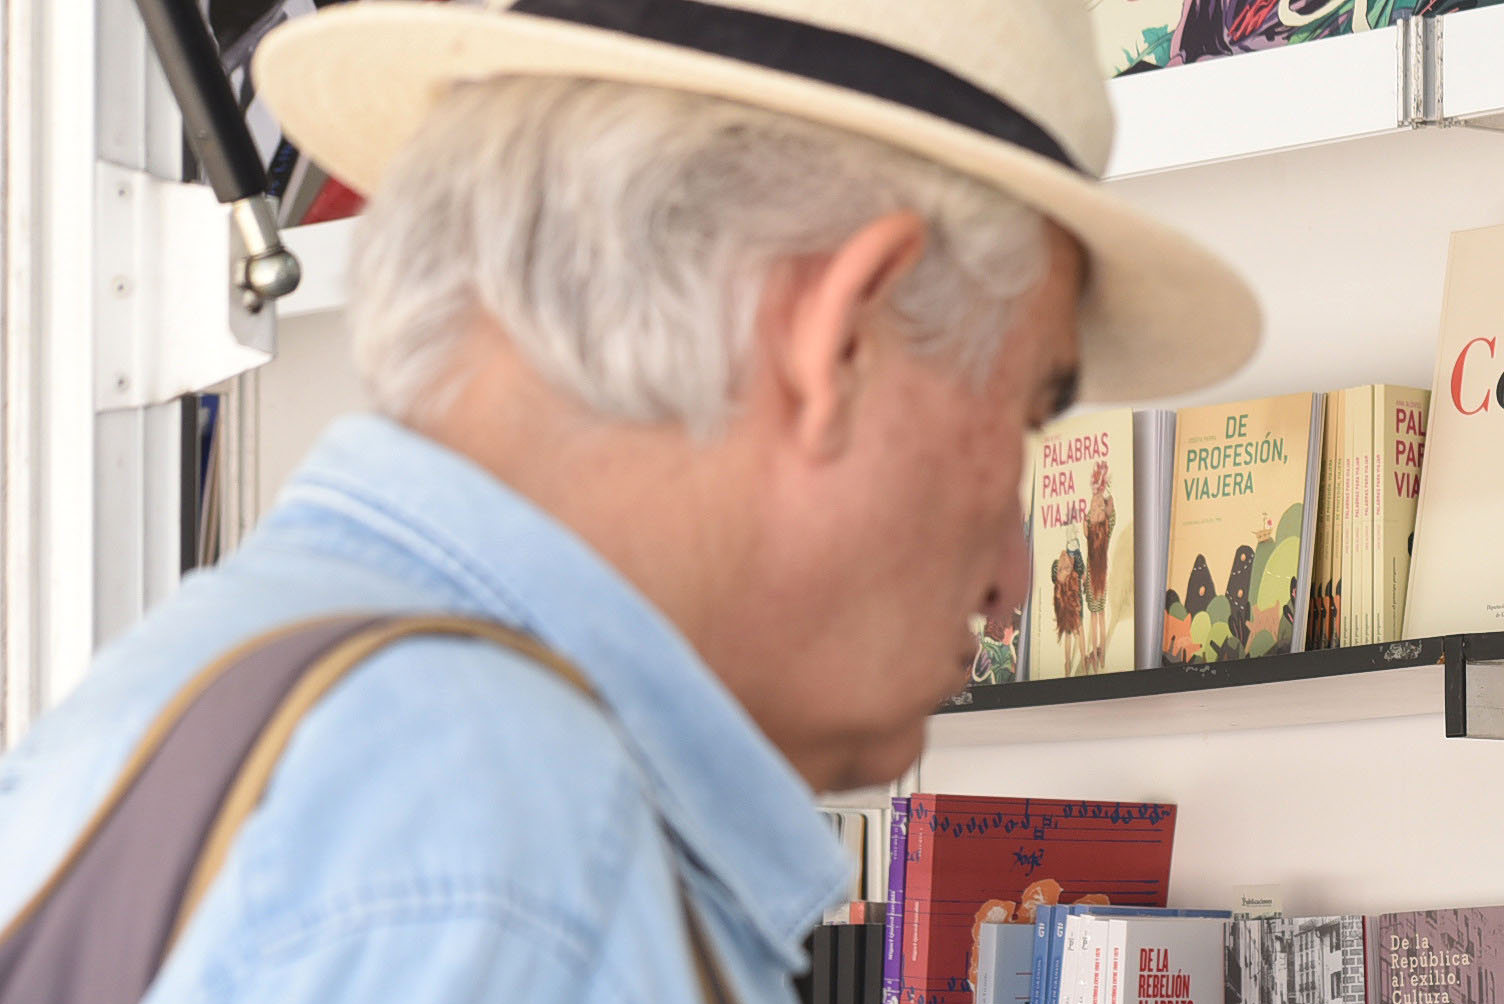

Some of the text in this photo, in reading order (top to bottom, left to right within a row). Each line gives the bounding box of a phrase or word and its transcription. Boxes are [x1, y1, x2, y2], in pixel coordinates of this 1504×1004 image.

[1225, 414, 1249, 439] DE
[1043, 432, 1108, 469] PALABRAS
[1186, 431, 1288, 473] PROFESIÓN,
[1043, 470, 1075, 499] PARA
[1184, 471, 1254, 501] VIAJERA
[1041, 498, 1087, 529] VIAJAR
[1391, 933, 1430, 951] De la
[1139, 948, 1169, 973] DE LA
[1391, 950, 1470, 973] República
[1138, 968, 1191, 999] REBELIÓN
[1392, 969, 1460, 988] al exilio.
